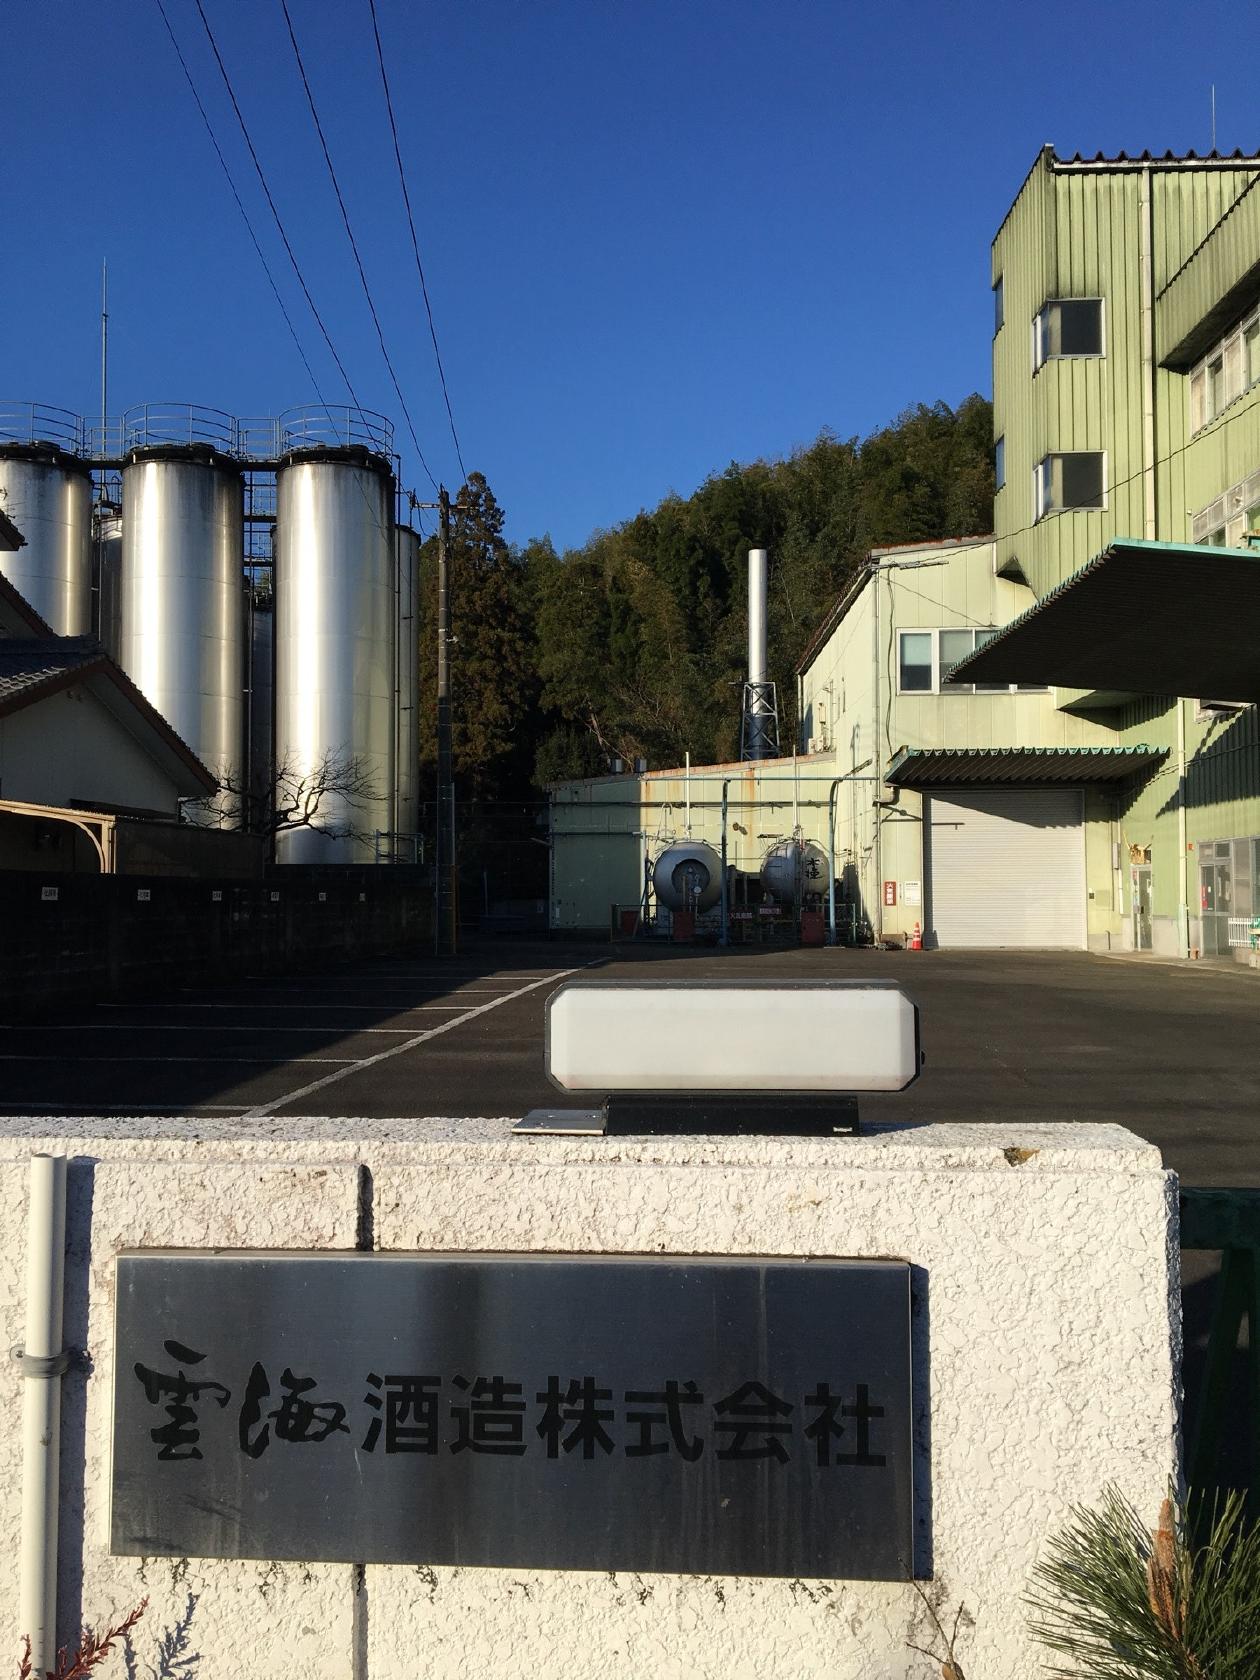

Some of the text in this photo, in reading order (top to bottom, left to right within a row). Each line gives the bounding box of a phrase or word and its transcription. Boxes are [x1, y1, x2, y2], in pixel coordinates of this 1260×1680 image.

[134, 1339, 887, 1467] 雲海酒造株式会社
